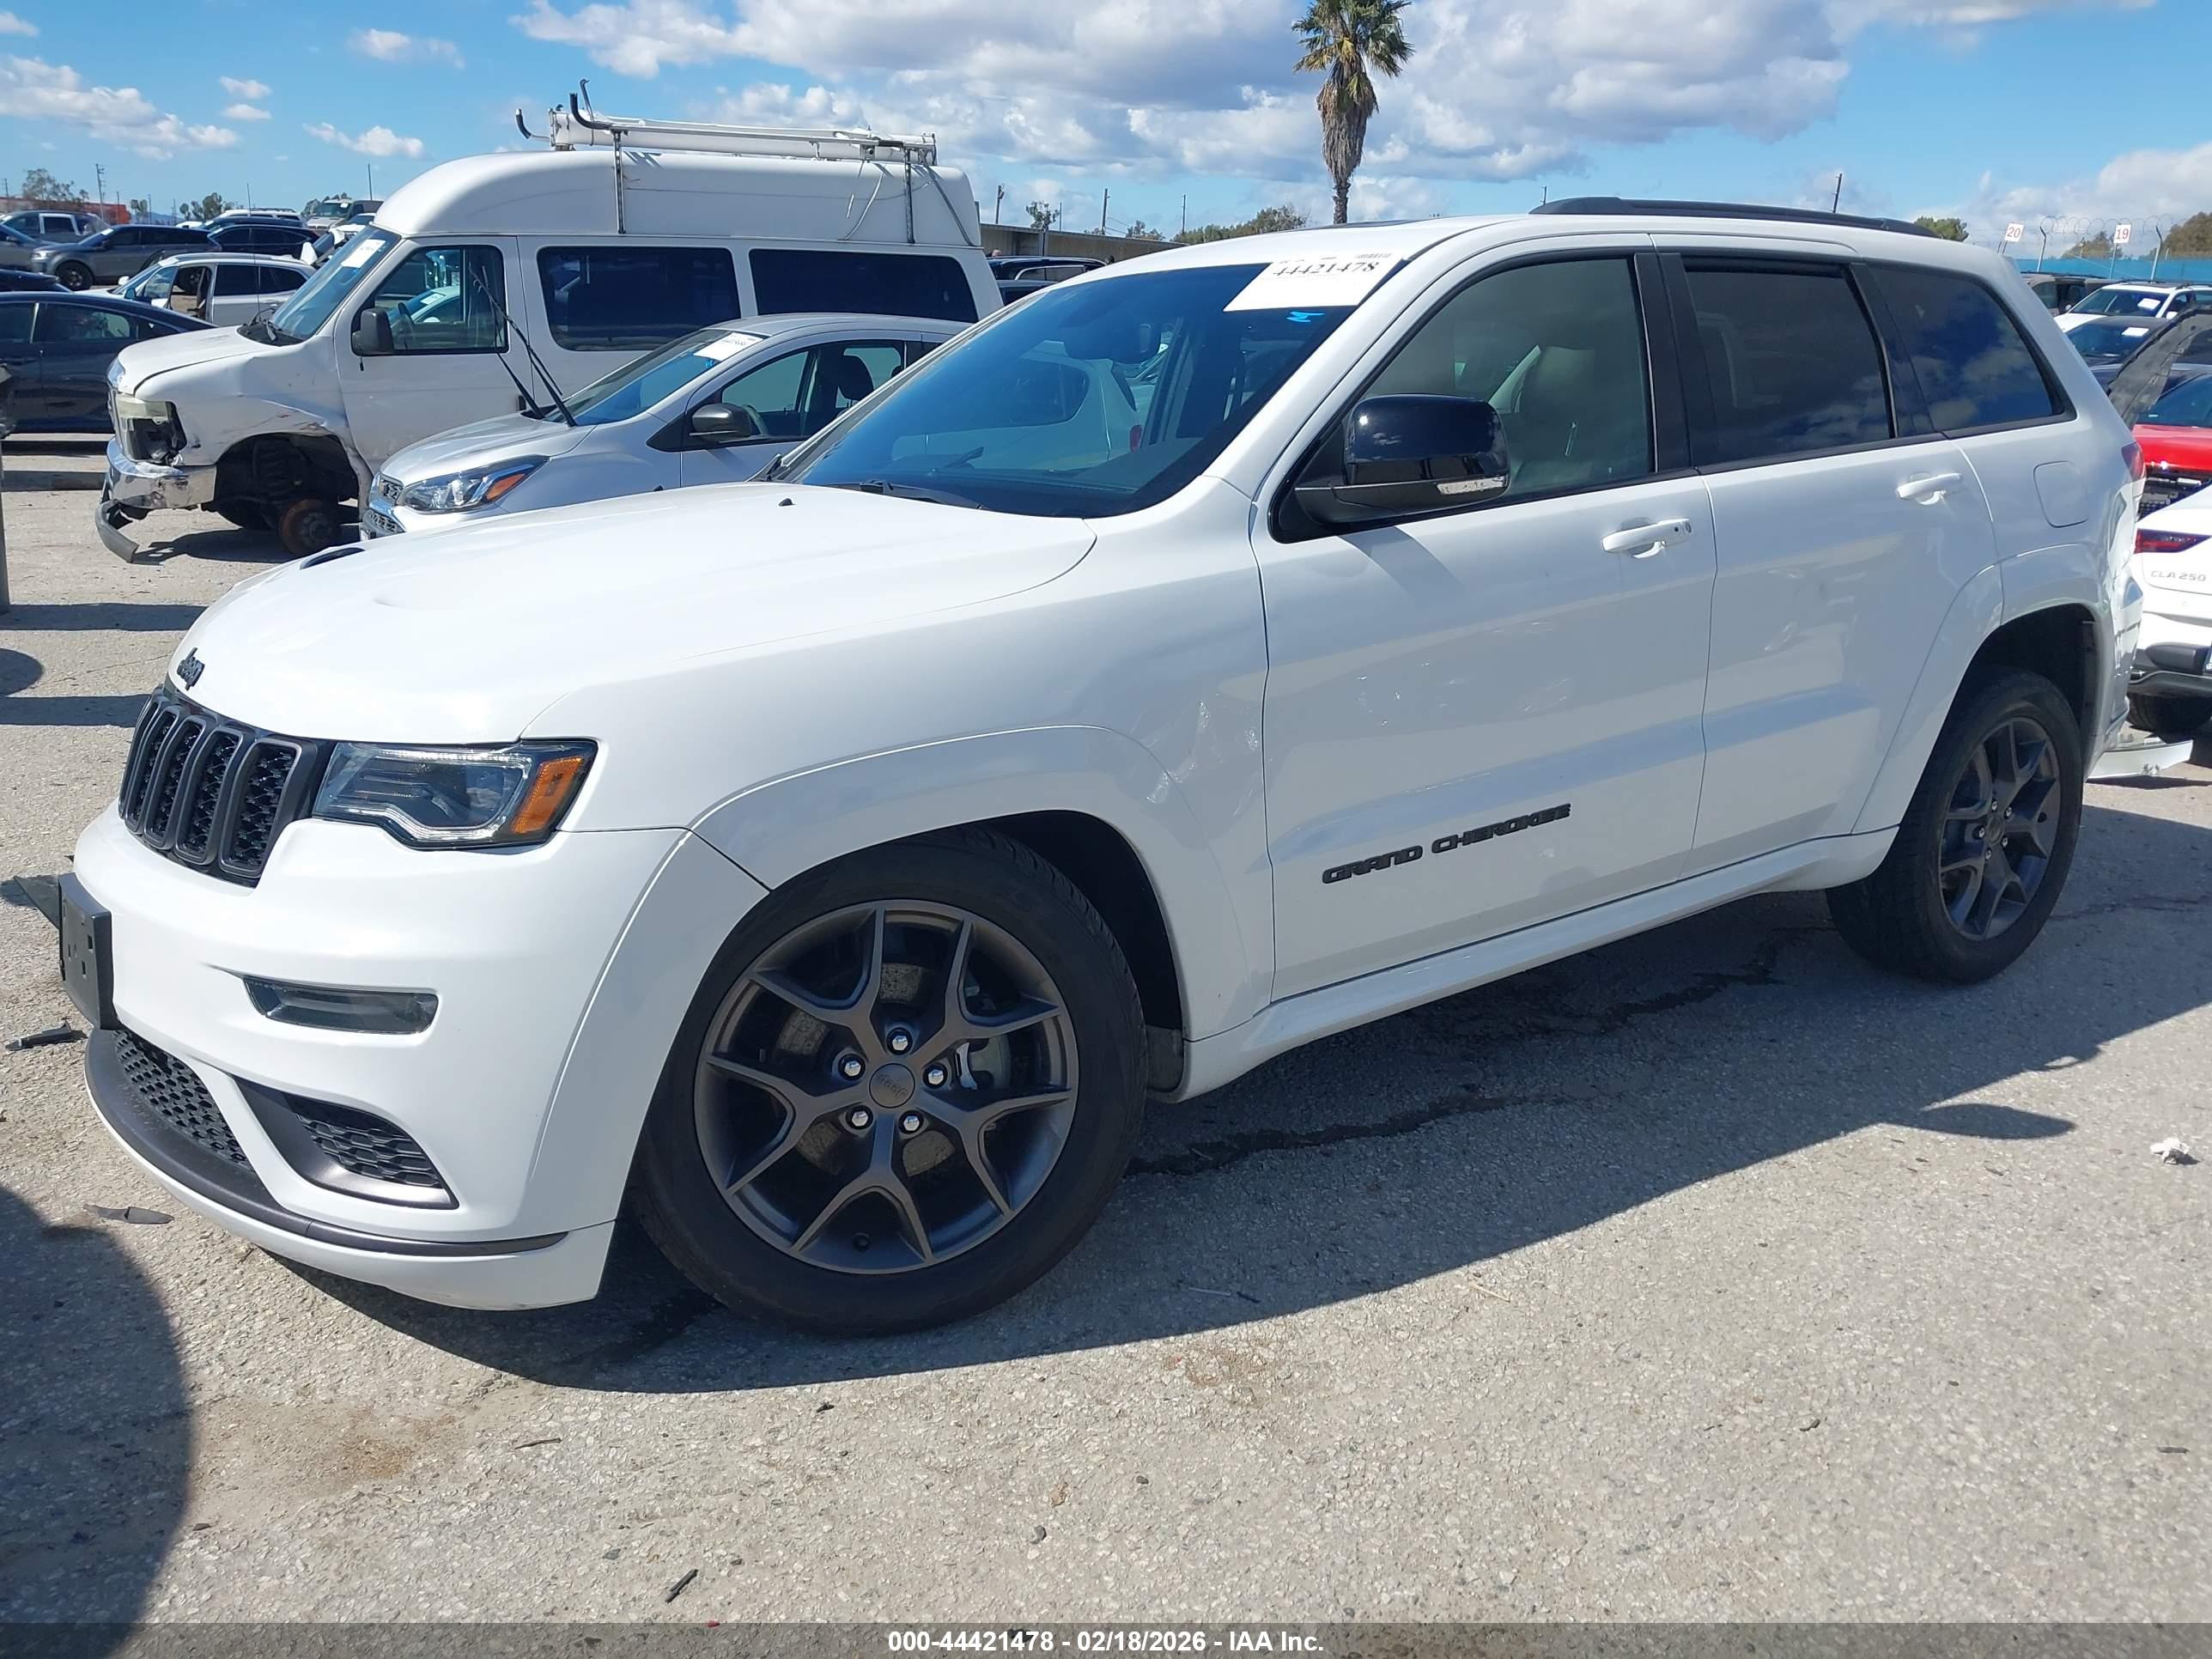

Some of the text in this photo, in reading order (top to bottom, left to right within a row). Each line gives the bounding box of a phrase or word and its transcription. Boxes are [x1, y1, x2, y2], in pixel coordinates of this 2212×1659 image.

[2007, 227, 2021, 239] 20
[2116, 228, 2129, 240] 19
[1322, 803, 1571, 884] GRAND CHEROKEE
